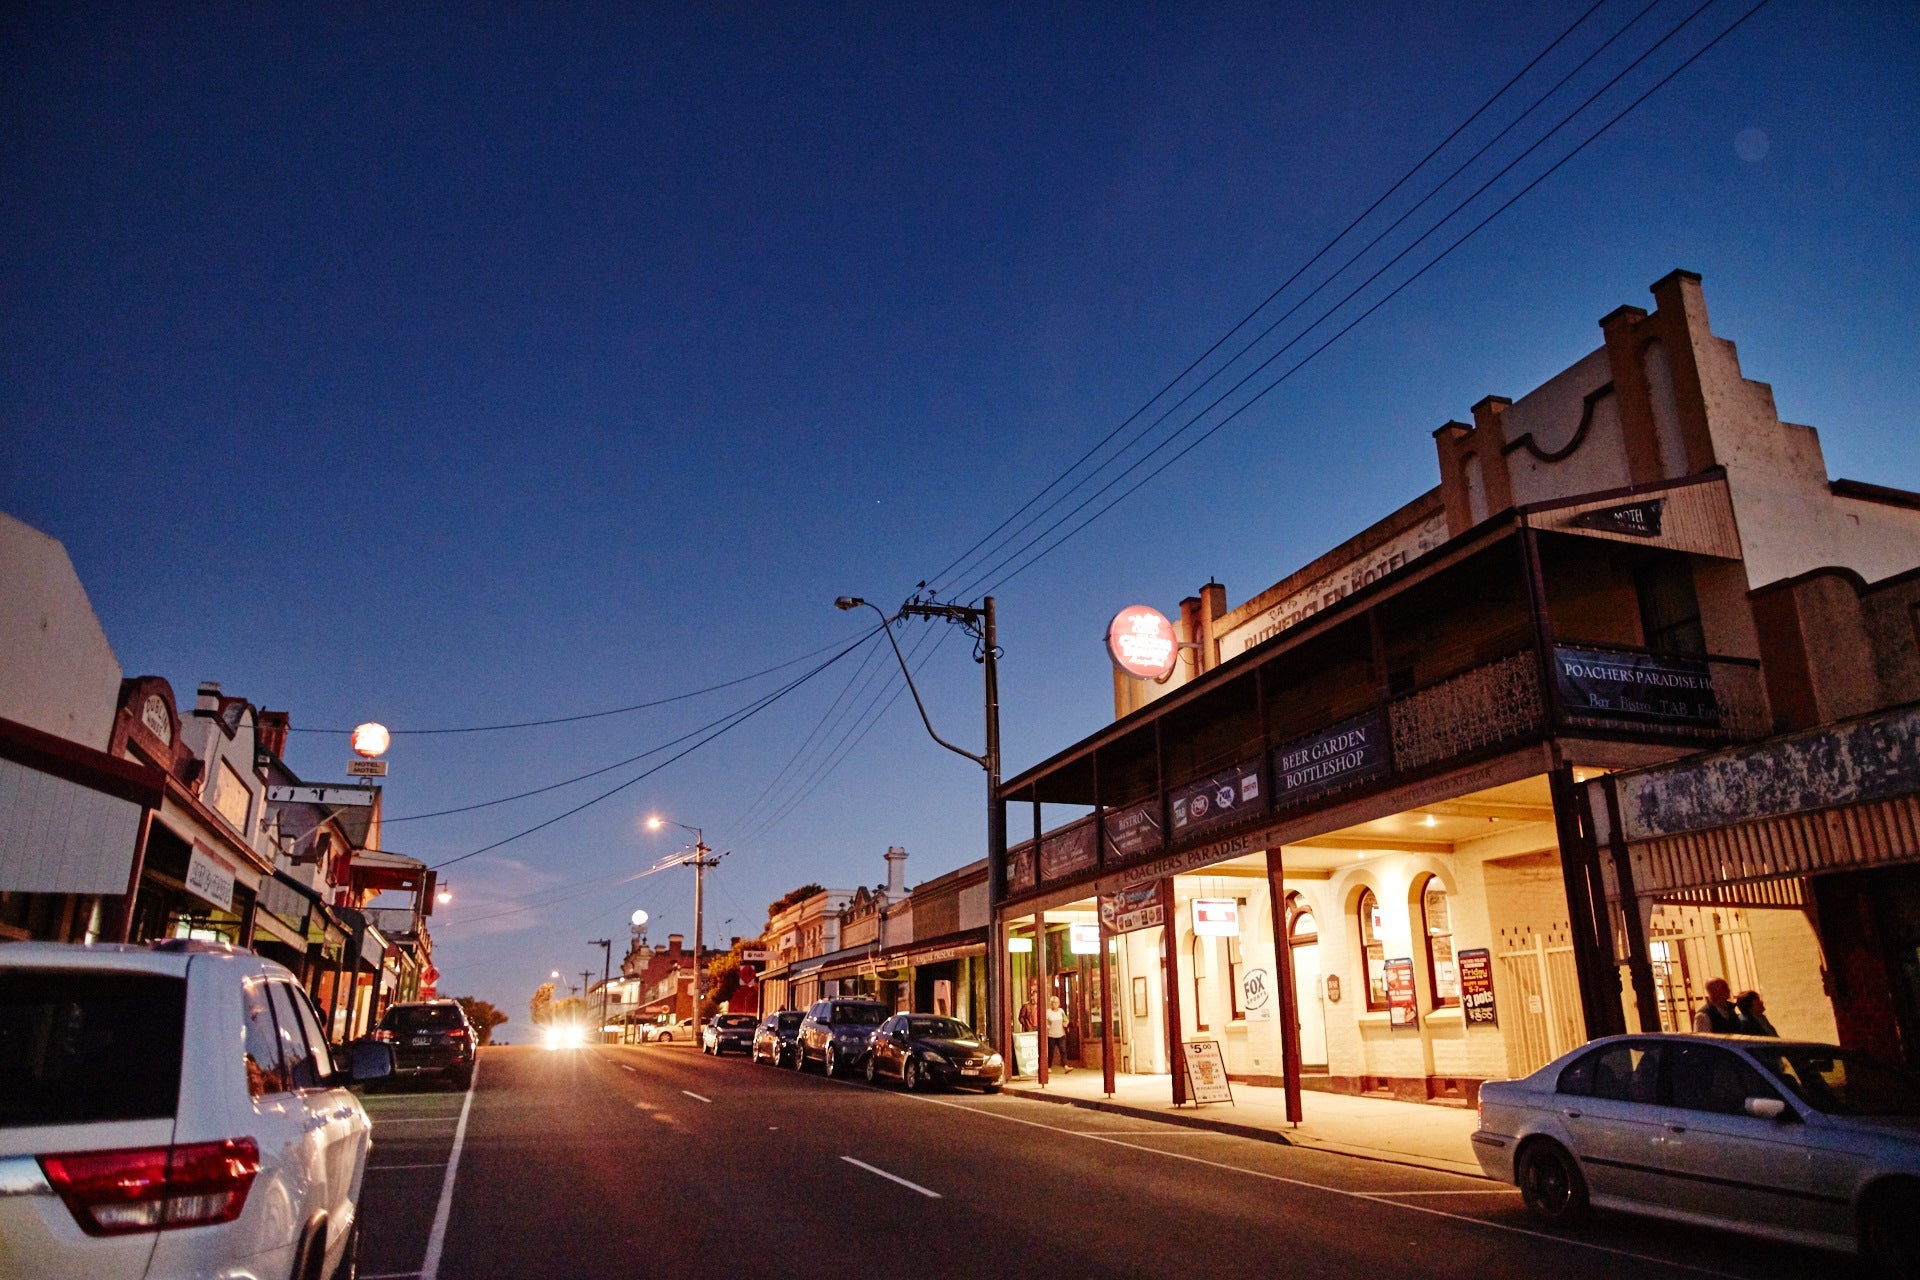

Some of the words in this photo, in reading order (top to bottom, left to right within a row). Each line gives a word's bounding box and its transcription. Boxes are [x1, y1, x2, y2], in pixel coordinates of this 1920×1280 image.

[1614, 508, 1643, 523] MOTEL
[1565, 662, 1635, 684] POACHERS
[1636, 671, 1698, 690] PARADISE
[1589, 693, 1610, 709] Bar
[1620, 696, 1651, 712] Bistro
[1660, 700, 1688, 716] TAB
[1282, 749, 1310, 771] BEER
[1312, 727, 1366, 760] GARDEN
[1286, 749, 1364, 789] BOTTLESHOP
[1118, 812, 1144, 831] BISTRO
[1124, 858, 1183, 881] POACHERS
[1187, 836, 1249, 865] PARADISE
[1462, 968, 1488, 978] Friday
[1244, 974, 1264, 999] FOX
[1473, 990, 1493, 1007] pots
